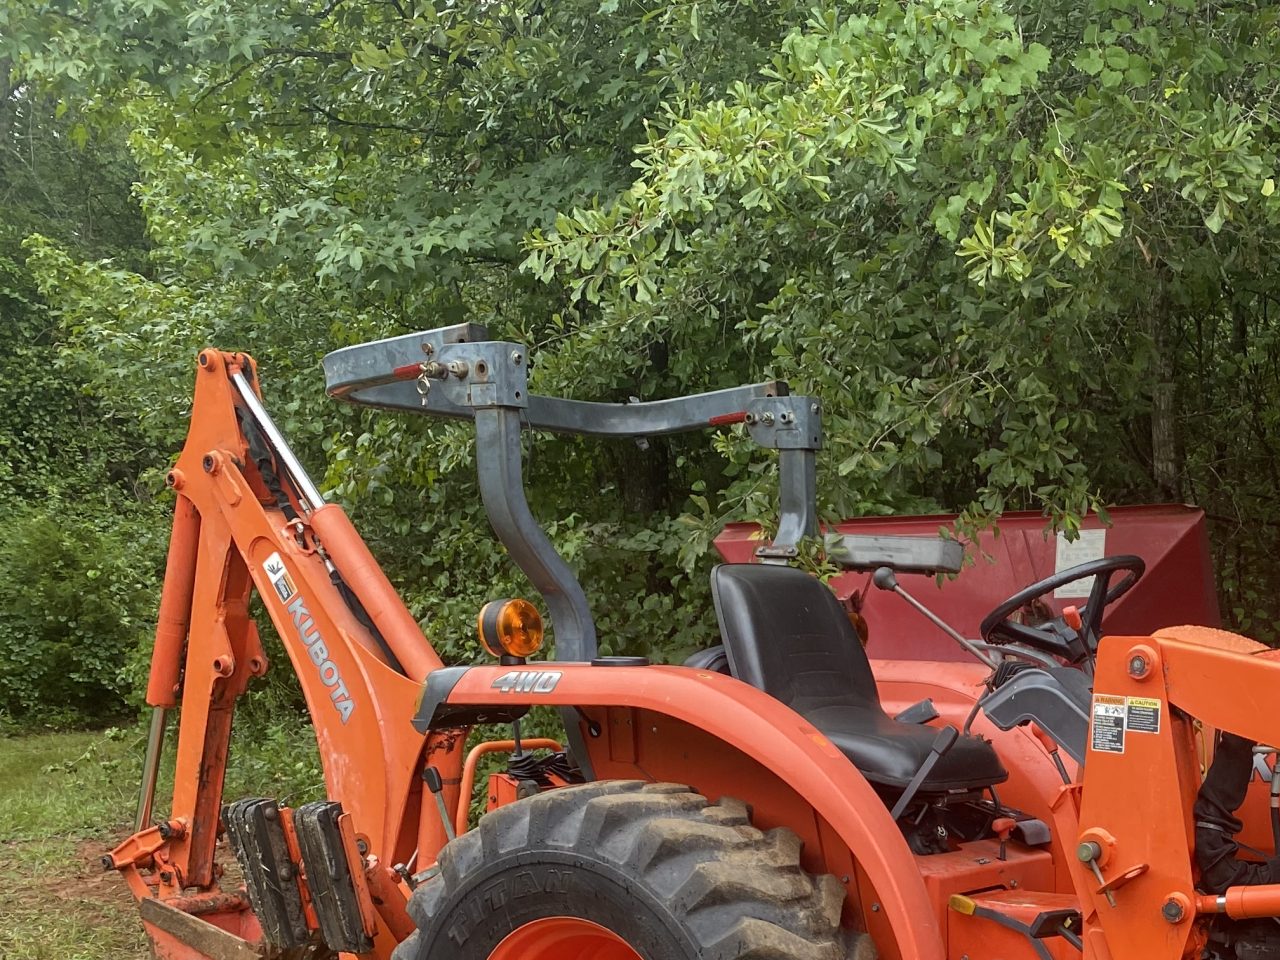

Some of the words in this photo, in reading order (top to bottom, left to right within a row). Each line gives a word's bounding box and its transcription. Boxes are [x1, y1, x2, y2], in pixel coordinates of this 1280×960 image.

[287, 597, 356, 725] KUBOTA
[491, 671, 563, 694] 4WD
[448, 869, 574, 947] TITAN
